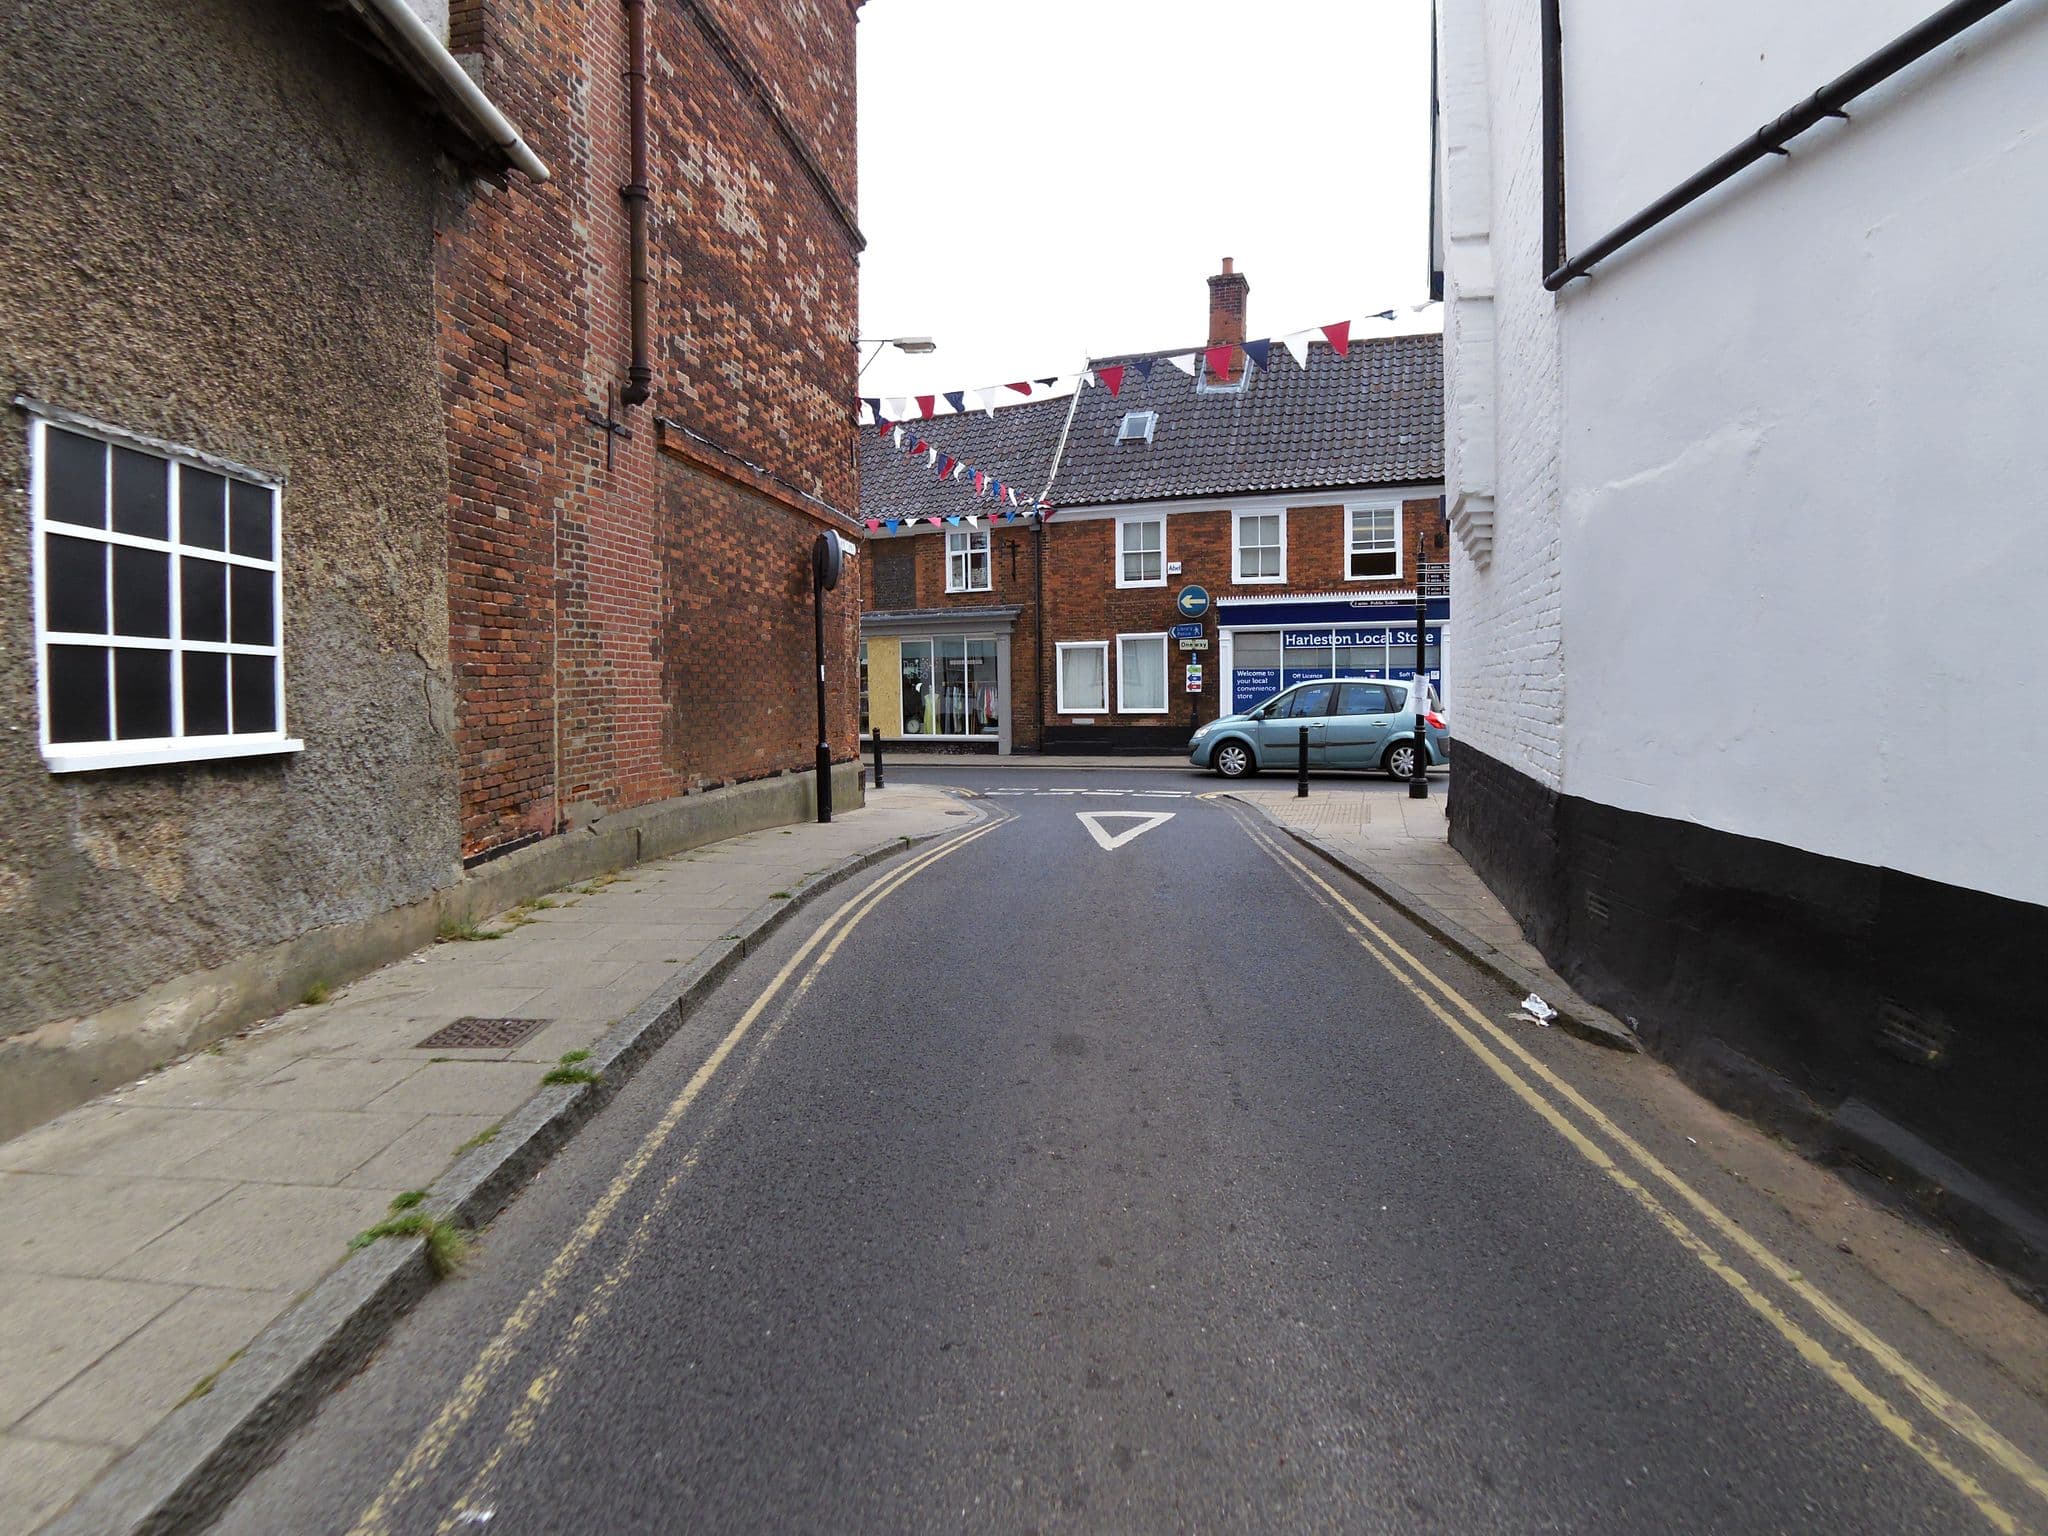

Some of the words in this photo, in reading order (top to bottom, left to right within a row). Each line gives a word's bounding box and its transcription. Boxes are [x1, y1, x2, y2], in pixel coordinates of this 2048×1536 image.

[1285, 633, 1351, 645] Harleston
[1356, 632, 1393, 644] Local
[1397, 631, 1433, 643] Stoe
